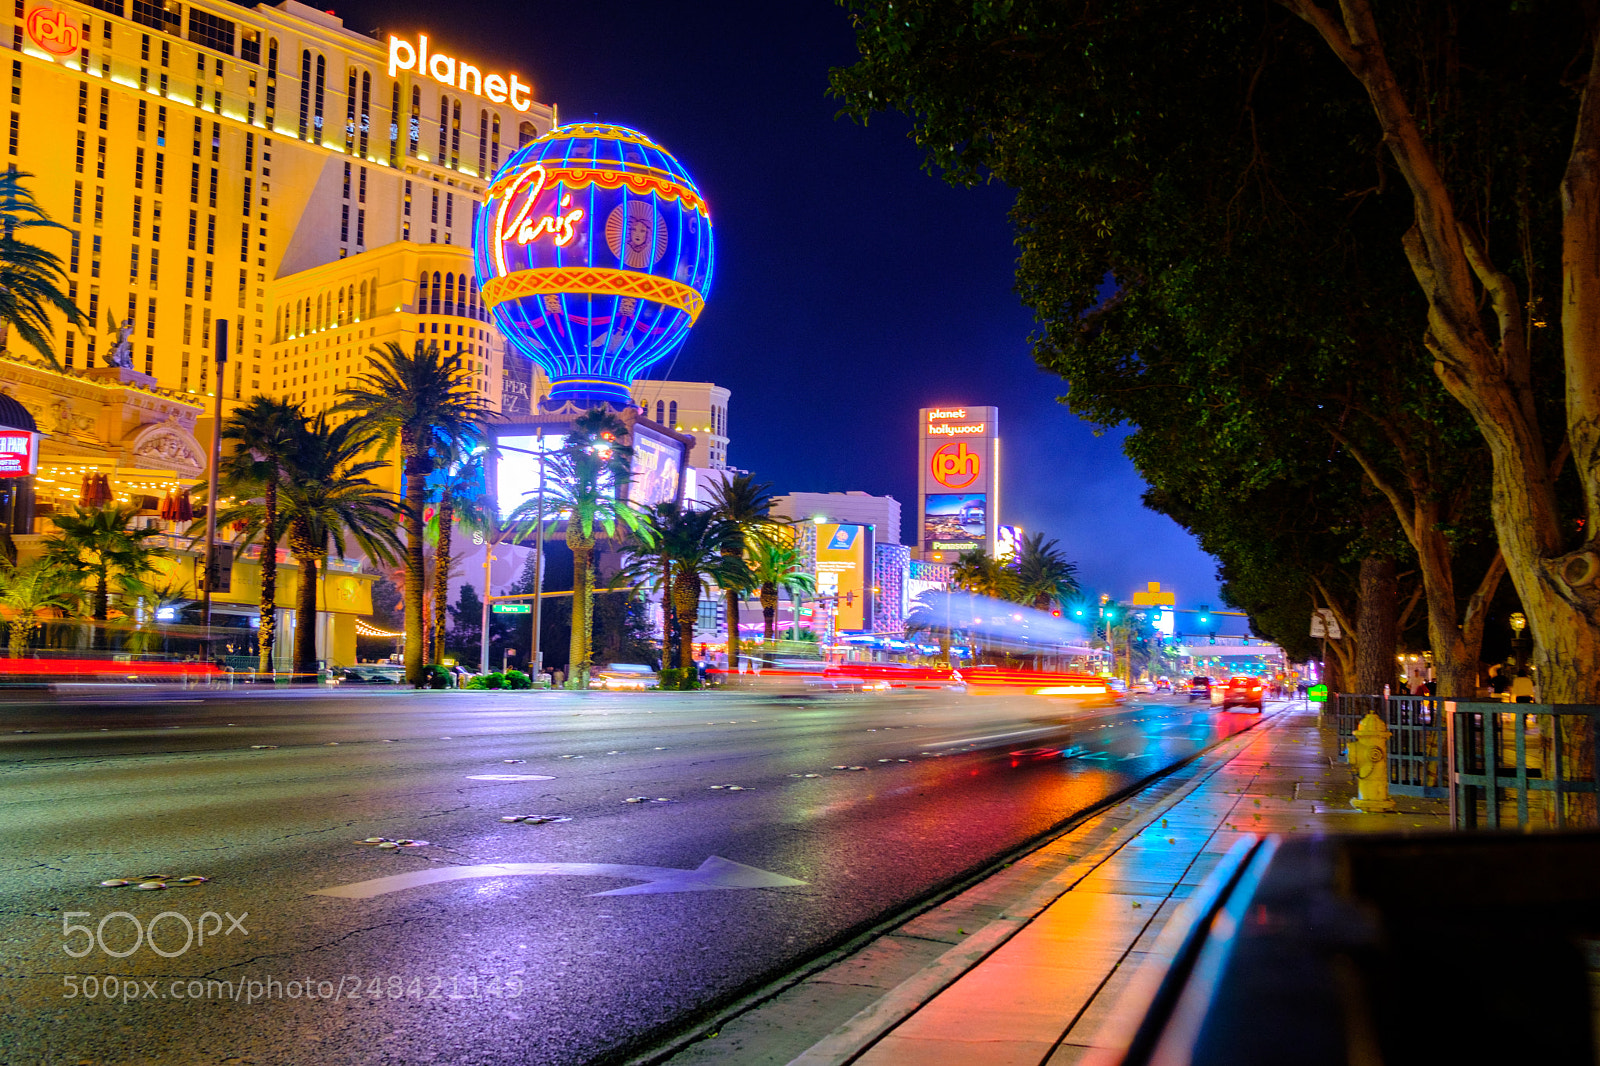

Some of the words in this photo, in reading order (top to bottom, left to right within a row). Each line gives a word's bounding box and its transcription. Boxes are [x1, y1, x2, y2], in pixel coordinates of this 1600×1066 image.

[33, 11, 78, 50] ph
[388, 34, 532, 112] planet
[494, 164, 584, 278] Paris
[928, 408, 967, 422] planet
[928, 423, 984, 436] hollywood
[7, 436, 28, 455] PARK
[936, 442, 980, 485] ph
[932, 541, 978, 550] Panasonic
